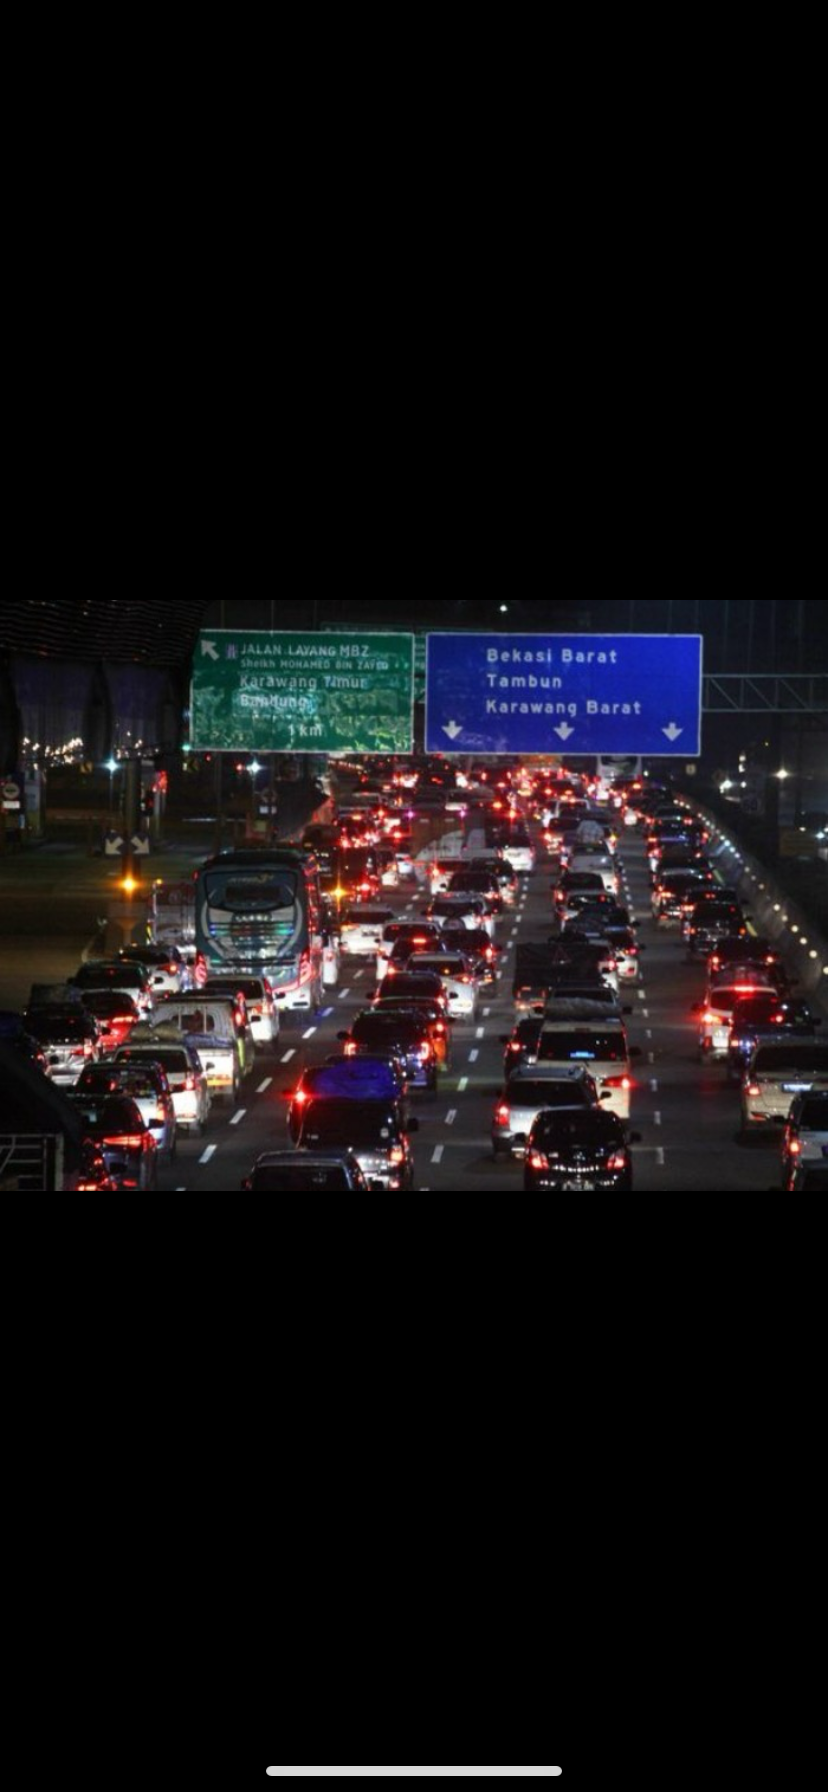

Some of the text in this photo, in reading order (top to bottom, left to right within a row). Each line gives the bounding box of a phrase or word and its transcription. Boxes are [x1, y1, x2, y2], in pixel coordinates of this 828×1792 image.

[240, 644, 369, 657] JALAN LAYANG MBZ
[487, 648, 618, 664] Bekasi Barat
[241, 660, 276, 668] Sheikh
[280, 660, 330, 669] MOHAMED
[335, 661, 352, 669] BIN
[240, 676, 366, 691] Karawang Timur
[487, 673, 562, 688] Tambun
[486, 700, 641, 717] Karawang Barat
[299, 723, 323, 736] km
